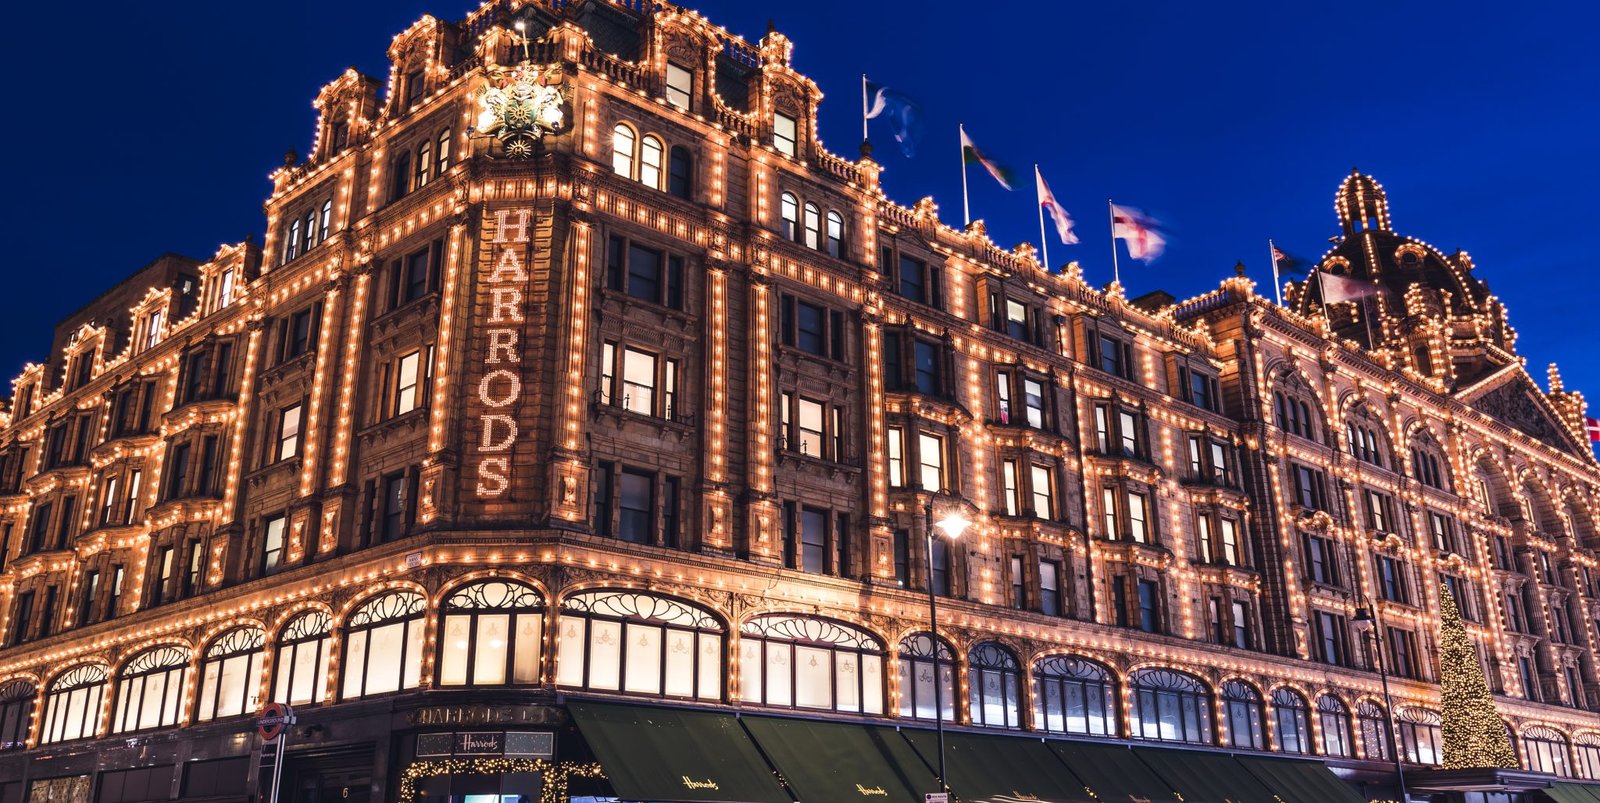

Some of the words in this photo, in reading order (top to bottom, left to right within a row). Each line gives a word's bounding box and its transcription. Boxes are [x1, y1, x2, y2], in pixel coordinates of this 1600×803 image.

[476, 209, 531, 495] HARRODS
[460, 734, 498, 750] Harrods
[682, 776, 719, 790] Harrods
[343, 787, 349, 798] 6
